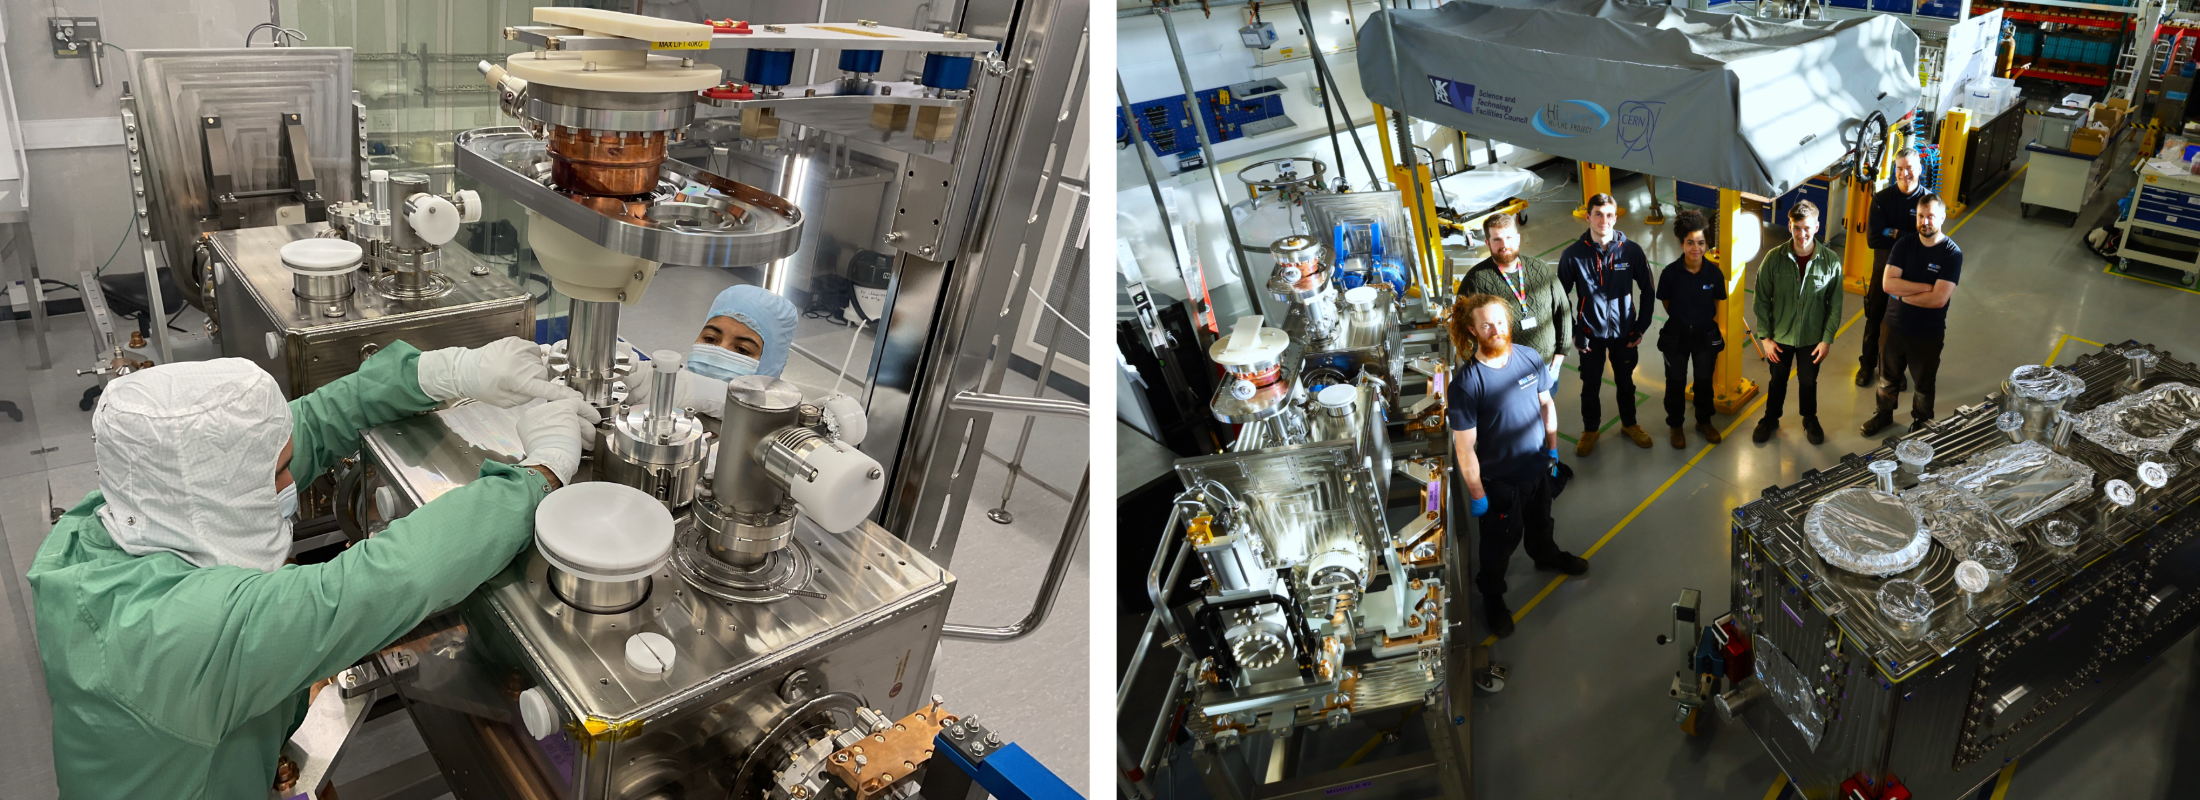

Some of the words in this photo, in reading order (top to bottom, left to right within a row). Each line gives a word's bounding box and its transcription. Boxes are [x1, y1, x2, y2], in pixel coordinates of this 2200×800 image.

[1478, 89, 1503, 101] Science
[1504, 96, 1516, 104] and
[1477, 98, 1513, 113] Technology
[1476, 106, 1503, 119] Facilities
[1503, 113, 1529, 124] Council
[1621, 113, 1646, 127] CERN
[1570, 124, 1593, 134] PROJECT
[1326, 783, 1361, 795] MODULE
